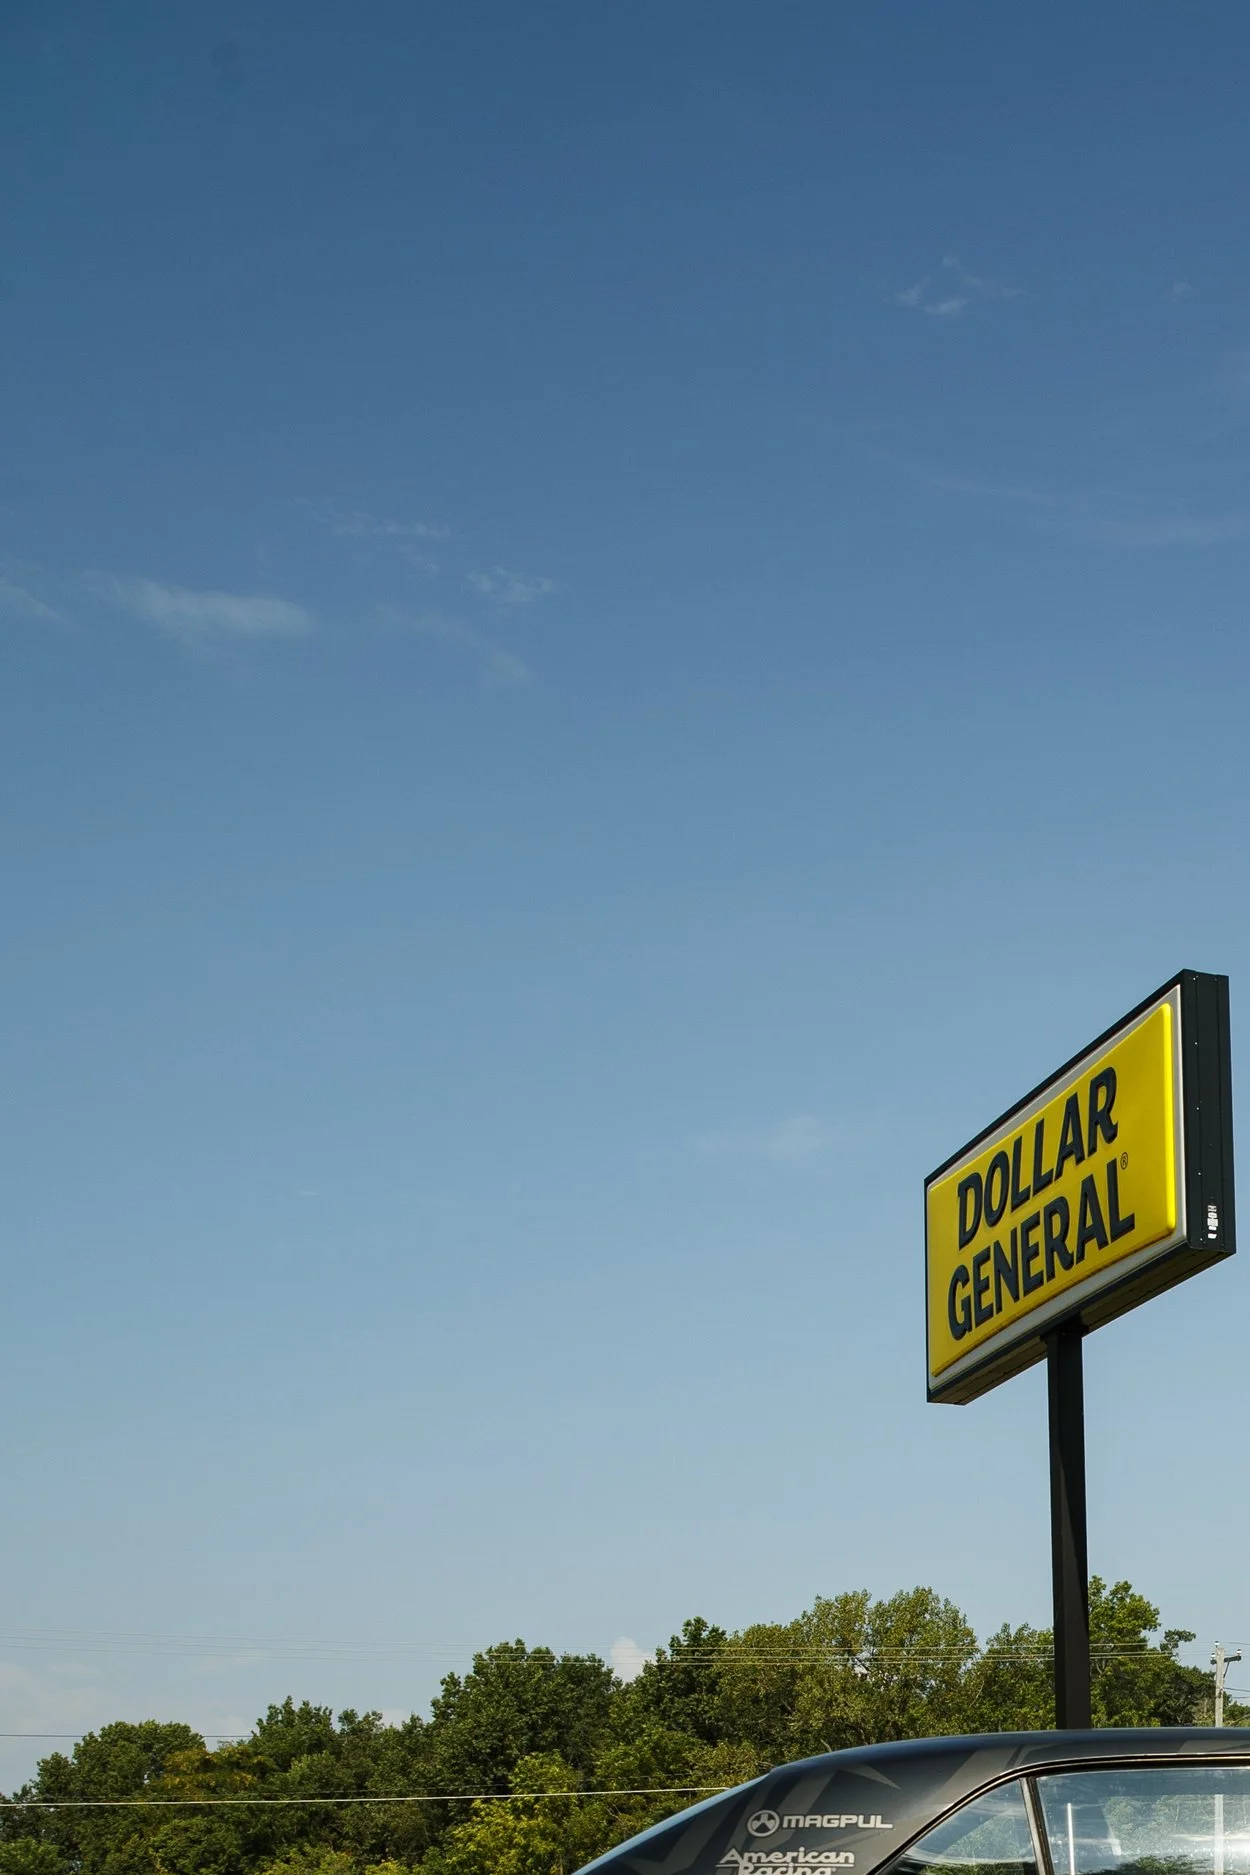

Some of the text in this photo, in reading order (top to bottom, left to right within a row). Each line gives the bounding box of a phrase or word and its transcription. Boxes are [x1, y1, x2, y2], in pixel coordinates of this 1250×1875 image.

[956, 1066, 1119, 1251] DOLLAR
[947, 1154, 1135, 1341] GENERAL
[716, 1847, 855, 1866] American
[782, 1814, 893, 1828] MAGPUL
